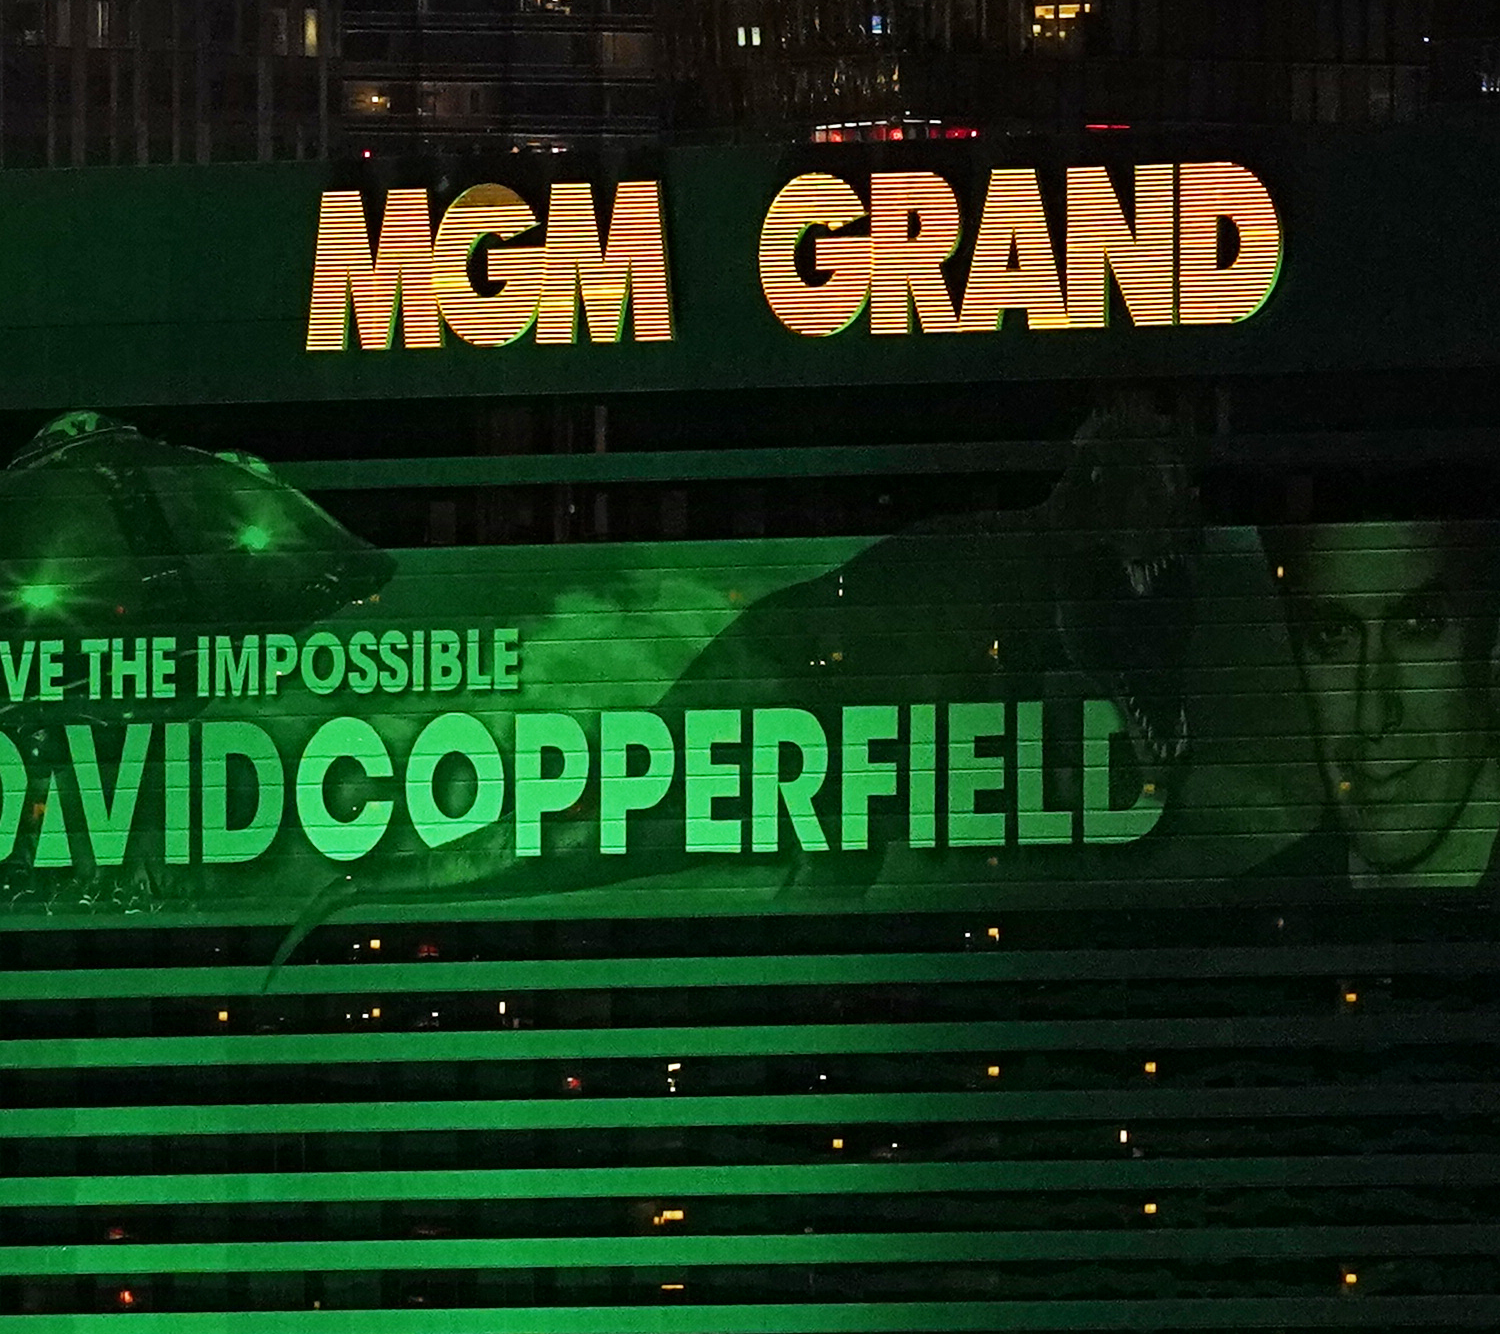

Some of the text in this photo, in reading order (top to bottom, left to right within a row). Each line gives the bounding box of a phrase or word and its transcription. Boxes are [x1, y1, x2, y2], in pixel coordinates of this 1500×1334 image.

[305, 161, 1284, 351] MGM GRAND
[80, 636, 177, 701] THE
[197, 628, 520, 697] IMPOSSIBLE
